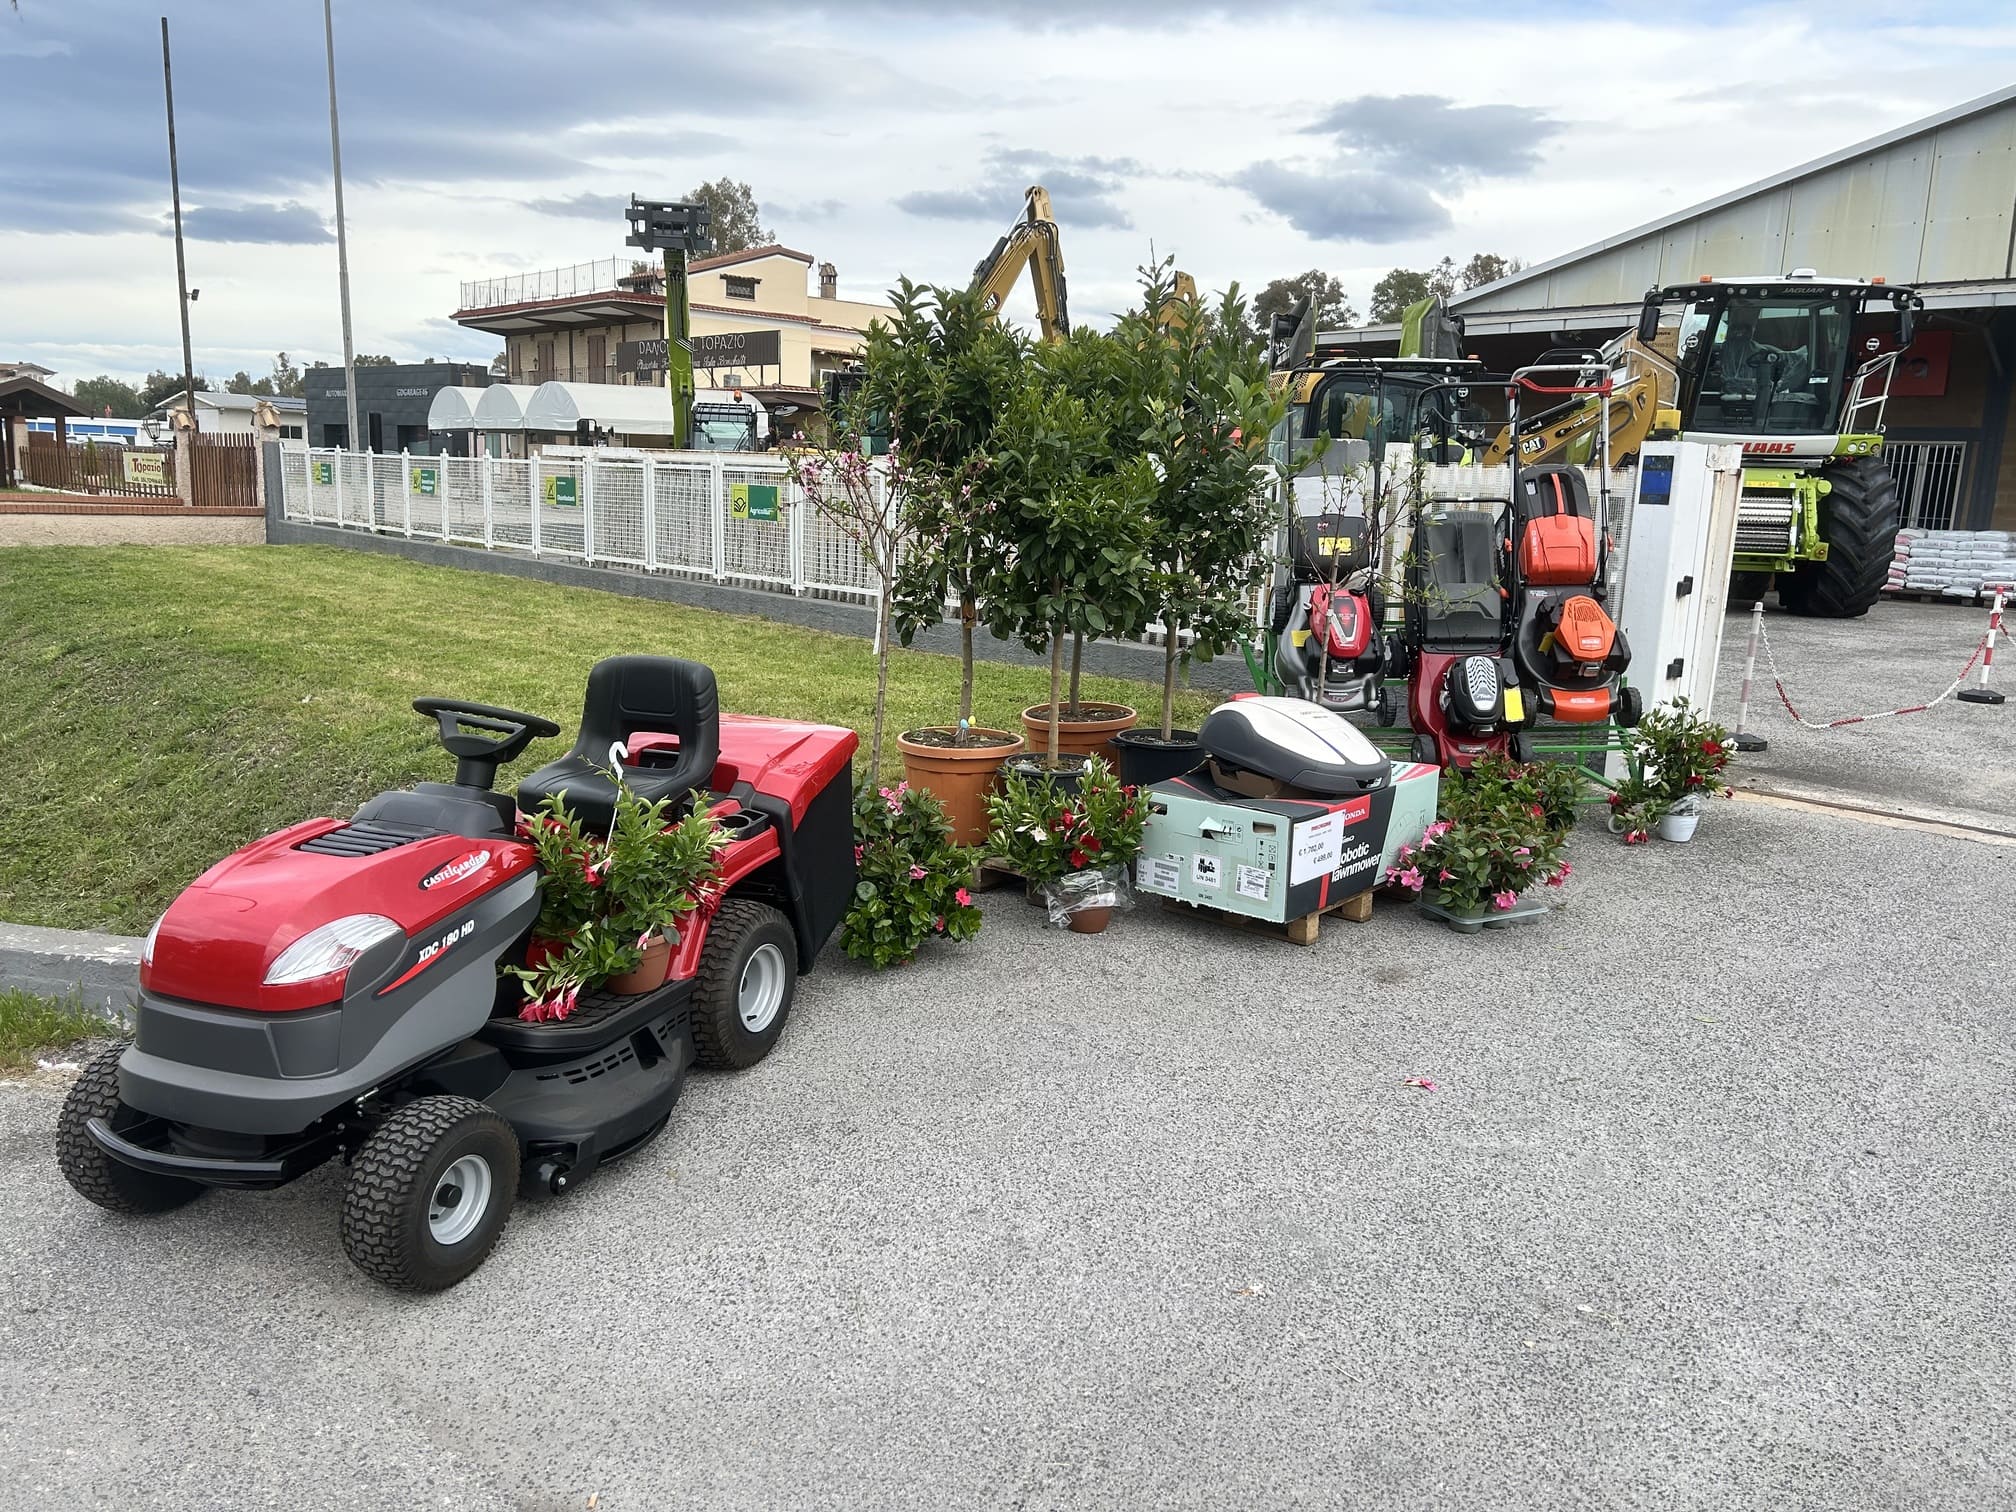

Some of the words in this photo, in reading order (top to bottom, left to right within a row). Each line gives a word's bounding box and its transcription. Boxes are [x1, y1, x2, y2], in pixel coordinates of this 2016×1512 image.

[701, 334, 745, 351] TOPAZIO
[1522, 436, 1541, 454] CAT
[1734, 442, 1796, 454] LAAS
[1345, 808, 1366, 821] ONDA
[1340, 842, 1370, 865] obotic
[1331, 853, 1382, 883] lawnmower
[418, 941, 439, 964] XDC
[460, 920, 475, 938] HD
